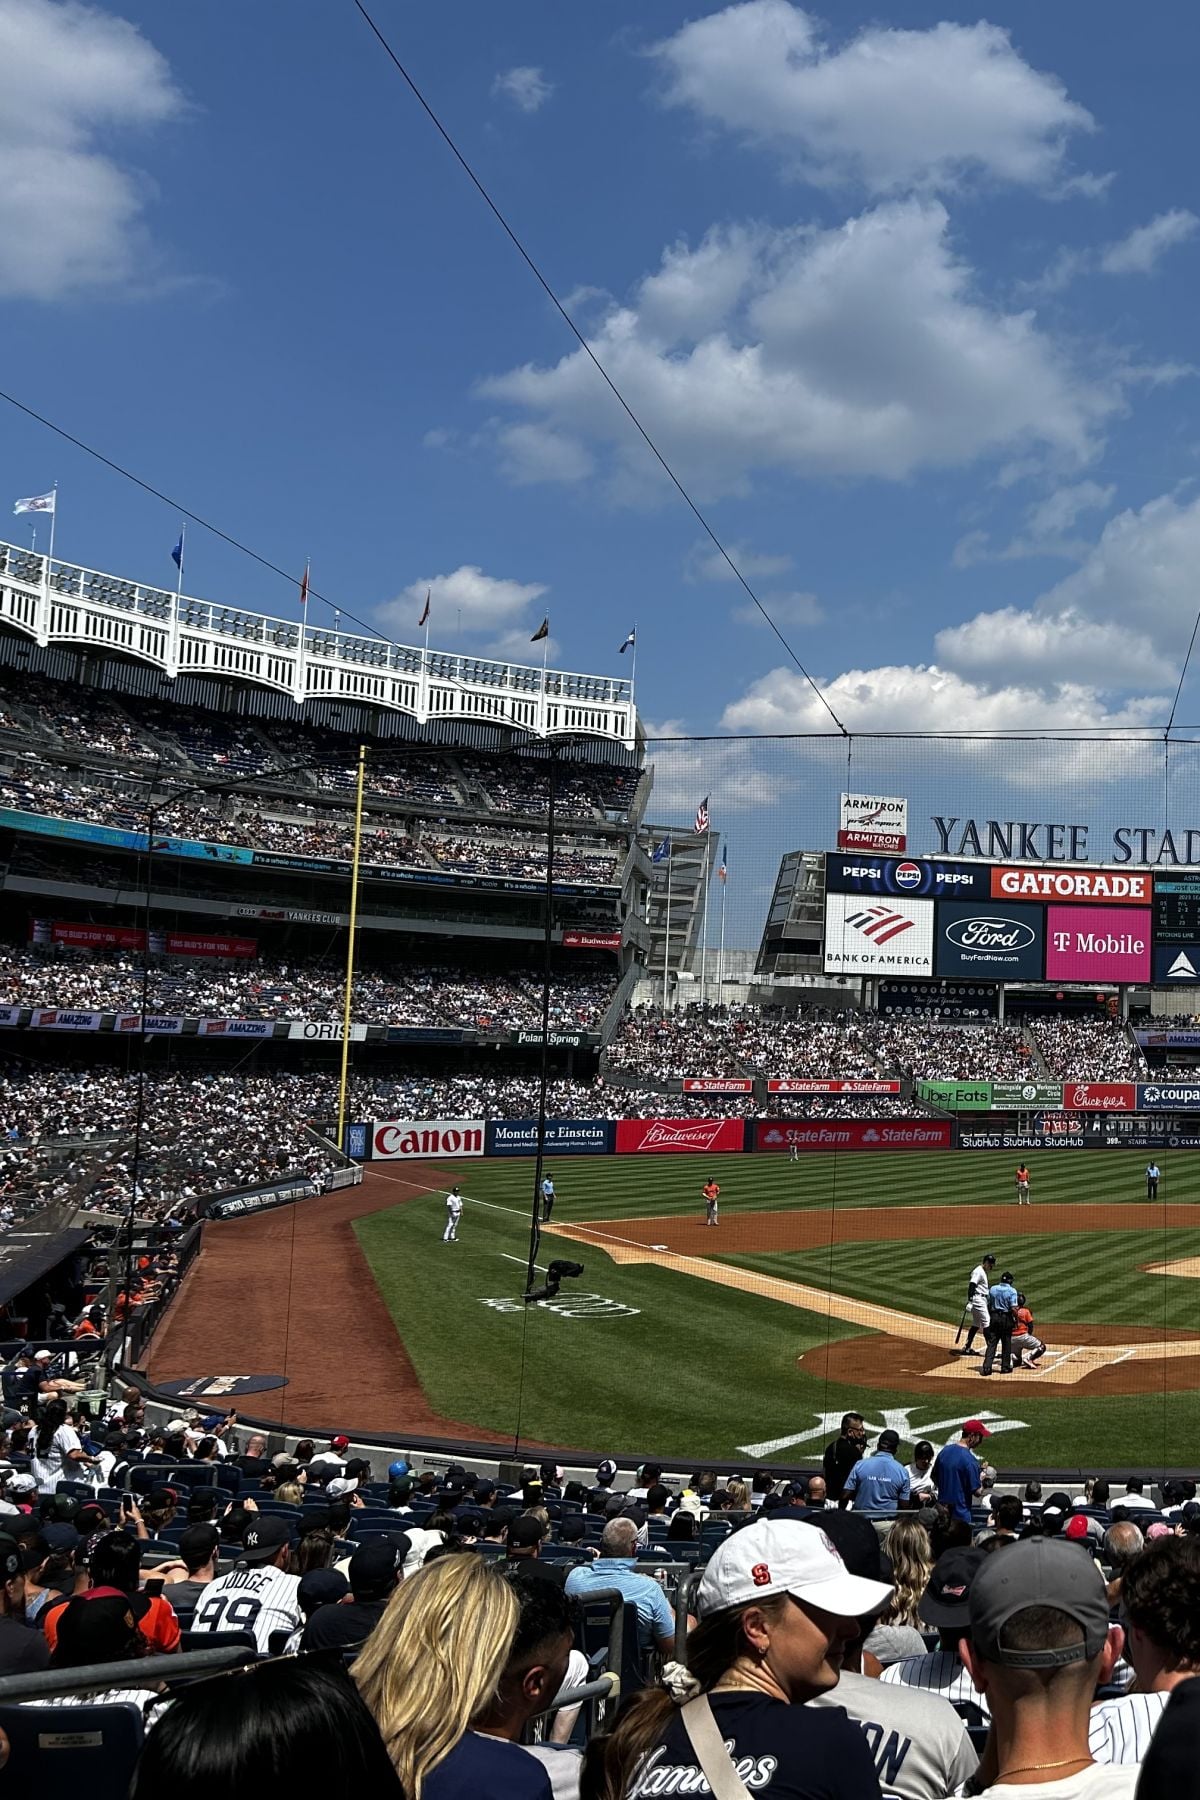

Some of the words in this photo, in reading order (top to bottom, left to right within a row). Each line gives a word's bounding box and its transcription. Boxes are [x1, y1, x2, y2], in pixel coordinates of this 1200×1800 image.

[844, 800, 903, 812] ARMITRON
[846, 833, 899, 844] ARMITRON
[931, 816, 1090, 860] YANKEE
[268, 857, 289, 867] whole
[396, 872, 414, 881] whole
[842, 866, 881, 879] PEPSI
[936, 873, 973, 884] PEPSI
[1001, 872, 1145, 898] GATORADE
[259, 909, 286, 919] Audi
[287, 912, 319, 922] YANKEES
[321, 915, 341, 924] CLUB
[55, 930, 68, 938] THIS
[68, 931, 88, 940] BUD'S
[961, 921, 1019, 947] Ford
[170, 939, 185, 947] THIS
[185, 941, 202, 949] BUD'S
[204, 942, 215, 950] FOR
[580, 936, 620, 946] Budweiser
[1053, 932, 1070, 952] T
[1076, 933, 1145, 955] Mobile
[827, 953, 858, 962] BANK
[861, 955, 876, 963] OF
[880, 956, 929, 965] AMERICA
[57, 1014, 92, 1026] AMAZING
[228, 1021, 266, 1033] AMAZING
[303, 1023, 351, 1039] ORIS
[550, 1033, 580, 1046] Spring
[703, 1081, 746, 1091] StateFarm
[790, 1081, 830, 1091] StateFarm
[852, 1081, 891, 1091] StateFarm
[921, 1087, 953, 1102] Uber
[956, 1090, 988, 1102] Eats
[1161, 1088, 1200, 1103] coupa
[495, 1127, 556, 1139] Montefire
[557, 1127, 604, 1138] Einstein
[648, 1128, 716, 1143] Budweiser
[785, 1129, 851, 1143] StateFarm
[881, 1128, 943, 1143] StateFarm
[374, 1126, 481, 1155] Canon
[962, 1138, 1000, 1147] StubHub
[1003, 1138, 1041, 1147] StubHub
[1044, 1138, 1083, 1147] StubHub
[216, 1572, 272, 1593] JUDGE
[198, 1596, 264, 1632] 99
